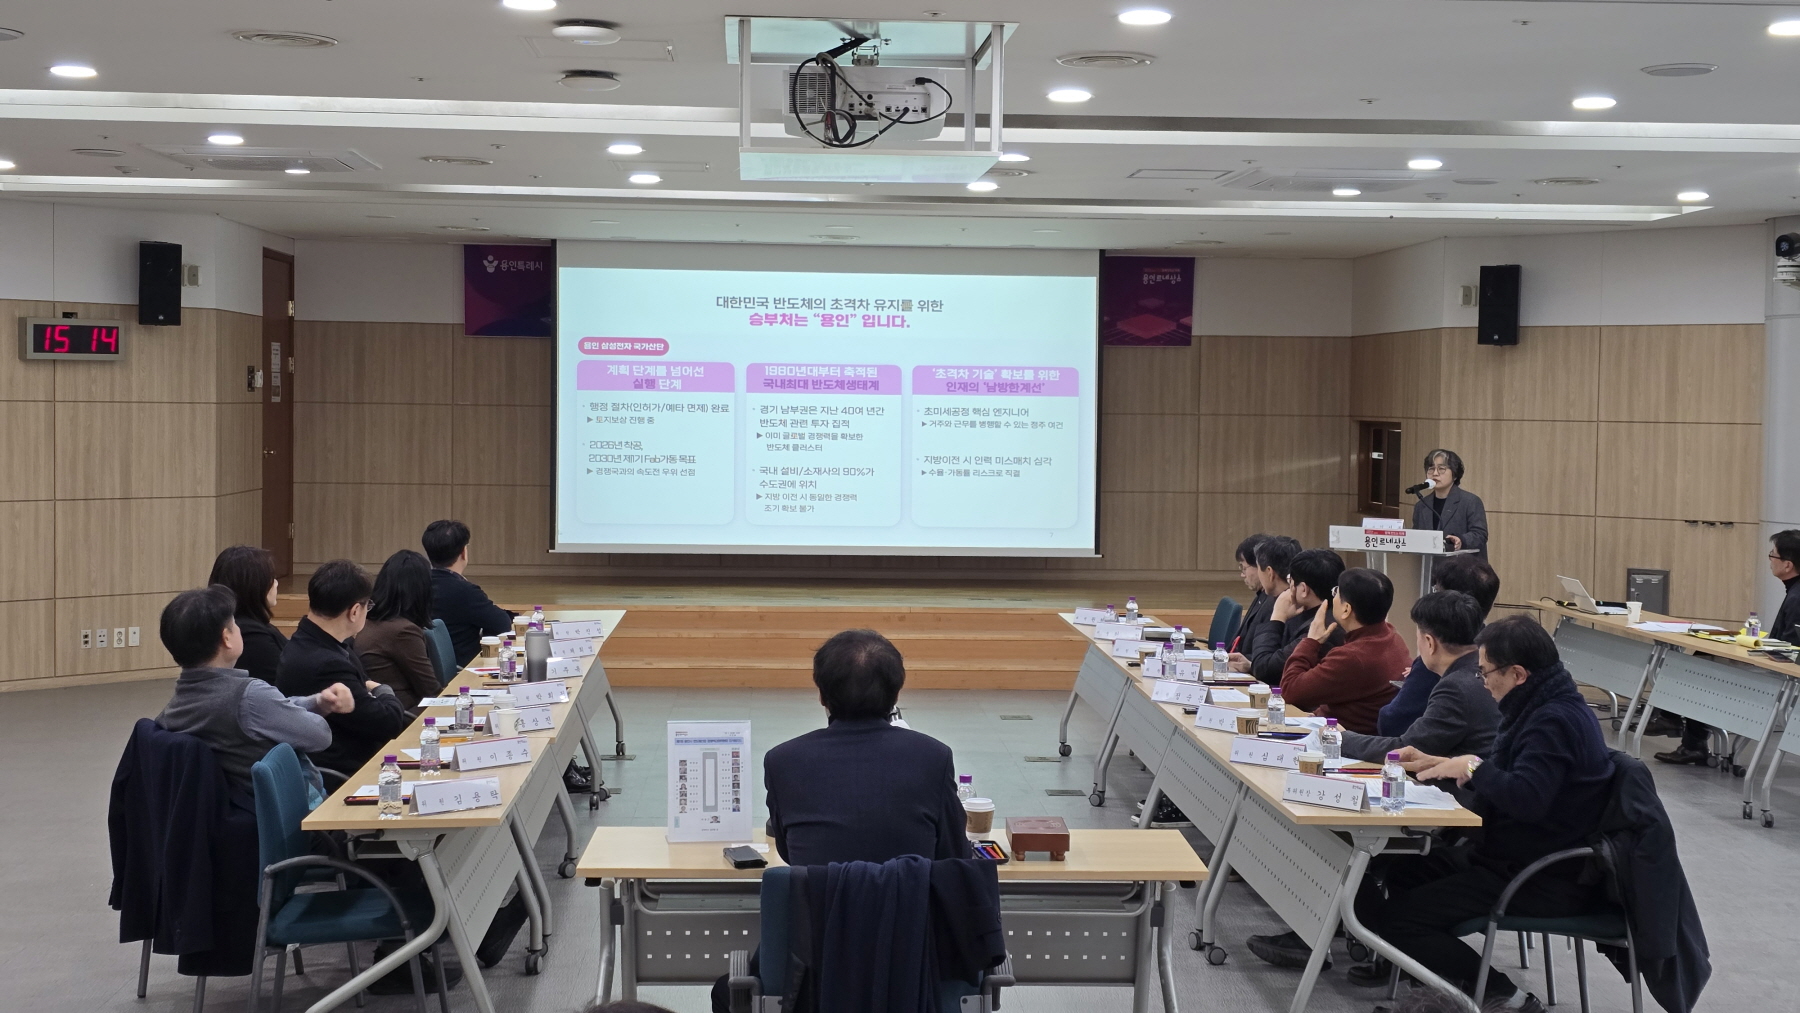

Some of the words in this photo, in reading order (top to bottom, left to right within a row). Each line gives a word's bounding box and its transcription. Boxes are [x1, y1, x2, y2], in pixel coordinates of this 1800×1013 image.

[716, 296, 770, 309] 대한민국
[773, 297, 826, 310] 반도체의
[830, 298, 871, 312] 초격차
[874, 298, 914, 312] 유지를
[917, 299, 944, 312] 위한
[749, 312, 808, 327] 승부처는
[862, 313, 910, 329] 입니다.
[44, 325, 70, 353] 15
[91, 327, 118, 352] 14
[583, 341, 600, 350] 용인
[601, 342, 632, 351] 삼성전자
[633, 342, 664, 351] 국가산단
[606, 364, 630, 376] 계획
[632, 364, 667, 377] 단계를
[670, 365, 705, 377] 넘어선
[764, 365, 841, 378] 1980년대부터
[843, 366, 878, 378] 축적된
[1001, 368, 1035, 380] 확보를
[1037, 369, 1060, 381] 위한
[632, 378, 656, 389] 실행
[658, 378, 682, 390] 단계
[763, 378, 808, 390] 국내최대
[811, 378, 880, 391] 반도체생태계
[946, 380, 979, 392] 인재의
[589, 402, 609, 412] 행정
[686, 403, 709, 413] 면제)
[711, 403, 730, 413] 완료
[760, 404, 778, 415] 경기
[780, 405, 818, 416] 남부권은
[820, 405, 838, 416] 지난
[841, 406, 864, 416] 40여
[866, 406, 885, 416] 년간
[923, 406, 970, 417] 초미세공정
[972, 406, 990, 417] 핵심
[992, 407, 1029, 418] 엔지니어
[595, 416, 627, 424] 토지보상
[629, 416, 645, 424] 진행
[647, 416, 655, 424] 중
[759, 418, 788, 429] 반도체
[790, 418, 808, 429] 관련
[811, 418, 829, 429] 투자
[832, 418, 850, 429] 집적
[928, 419, 952, 429] 거주와
[954, 420, 977, 429] 근무를
[1003, 420, 1012, 429] 수
[1013, 420, 1028, 429] 있는
[1030, 420, 1046, 430] 정주
[1048, 420, 1064, 430] 여건
[765, 431, 780, 441] 이미
[782, 431, 806, 441] 글로벌
[808, 432, 839, 441] 경쟁력을
[840, 432, 864, 441] 확보한
[589, 440, 623, 450] 2026년
[766, 442, 790, 452] 반도체
[792, 443, 823, 452] 클러스터
[588, 454, 622, 464] 2030년
[678, 454, 696, 464] 목표
[923, 455, 960, 466] 지방이전
[962, 455, 972, 466] 시
[974, 455, 993, 466] 인력
[995, 455, 1032, 466] 미스매치
[1034, 455, 1052, 466] 심각
[595, 467, 635, 476] 경쟁국과의
[636, 467, 660, 476] 속도전
[662, 468, 678, 476] 우위
[680, 468, 696, 476] 선점
[759, 466, 778, 476] 국내
[780, 466, 840, 477] 설비/소재사의
[842, 466, 874, 477] 90%가
[972, 468, 1003, 477] 리스크로
[1005, 468, 1020, 478] 직결
[759, 479, 796, 489] 수도권에
[799, 480, 817, 490] 위치
[764, 492, 780, 501] 지방
[782, 492, 798, 501] 이전
[800, 492, 808, 501] 시
[809, 492, 832, 502] 동일한
[834, 493, 858, 502] 경쟁력
[764, 504, 780, 513] 조기
[781, 504, 797, 513] 확보
